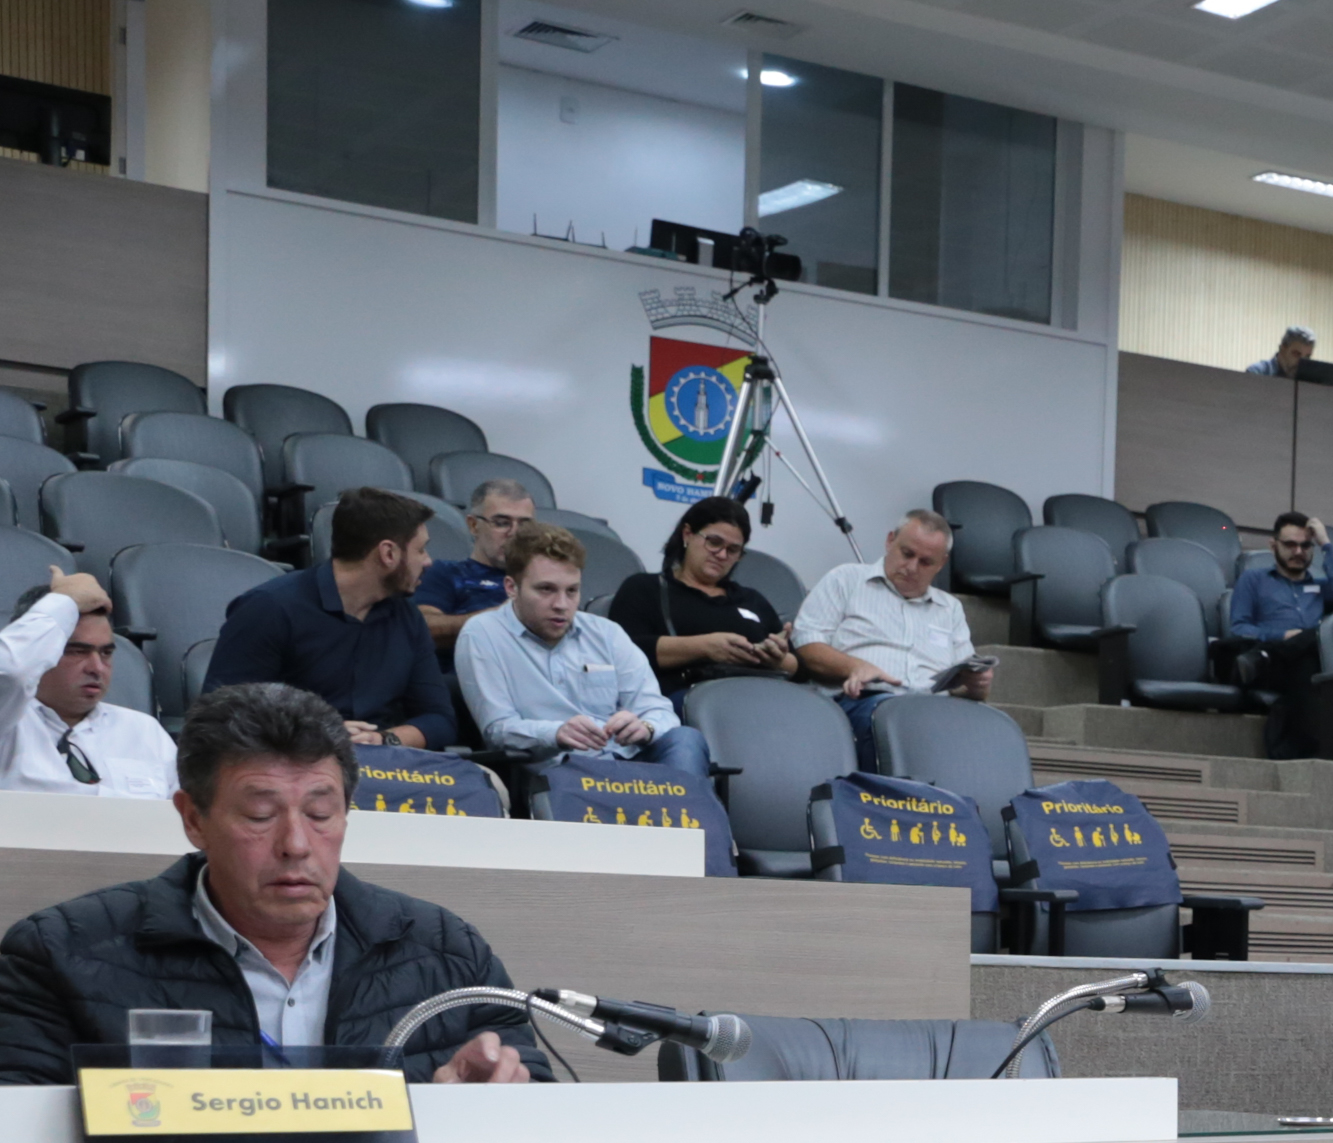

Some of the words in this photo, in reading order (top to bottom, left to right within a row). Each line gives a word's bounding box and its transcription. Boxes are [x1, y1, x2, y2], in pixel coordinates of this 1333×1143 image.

[657, 482, 685, 495] NOVO
[358, 766, 455, 787] rioritário
[580, 776, 686, 796] Prioritário
[860, 792, 954, 815] Prioritário
[1042, 801, 1124, 815] Prioritário
[191, 1091, 283, 1117] Sergio
[290, 1090, 384, 1111] Hanich
